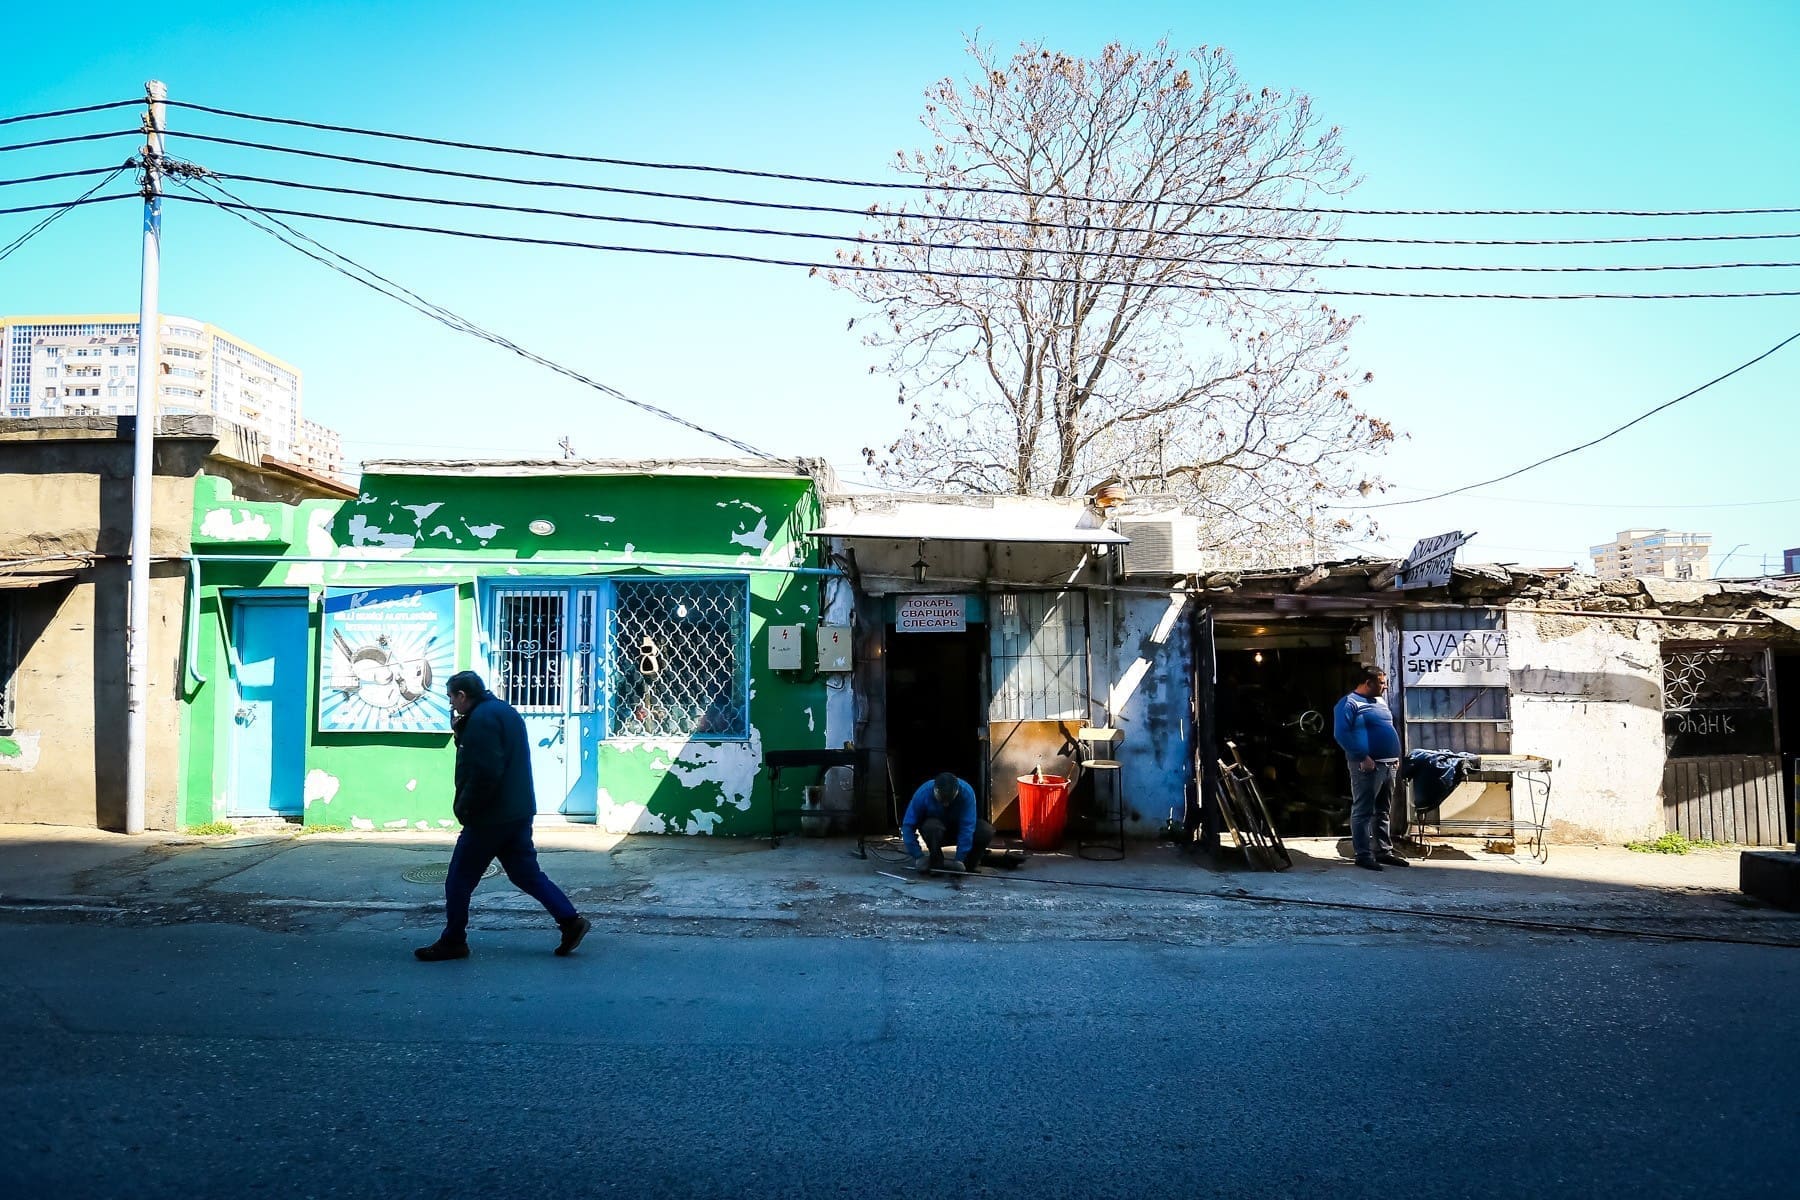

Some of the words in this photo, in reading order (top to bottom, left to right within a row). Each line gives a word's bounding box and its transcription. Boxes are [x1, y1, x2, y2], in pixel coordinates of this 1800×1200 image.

[907, 599, 953, 607] ТОКАРЬ
[901, 609, 960, 618] СВАРЩИК
[903, 620, 958, 628] СЛЕСАРЬ
[1409, 631, 1507, 657] SVARKA
